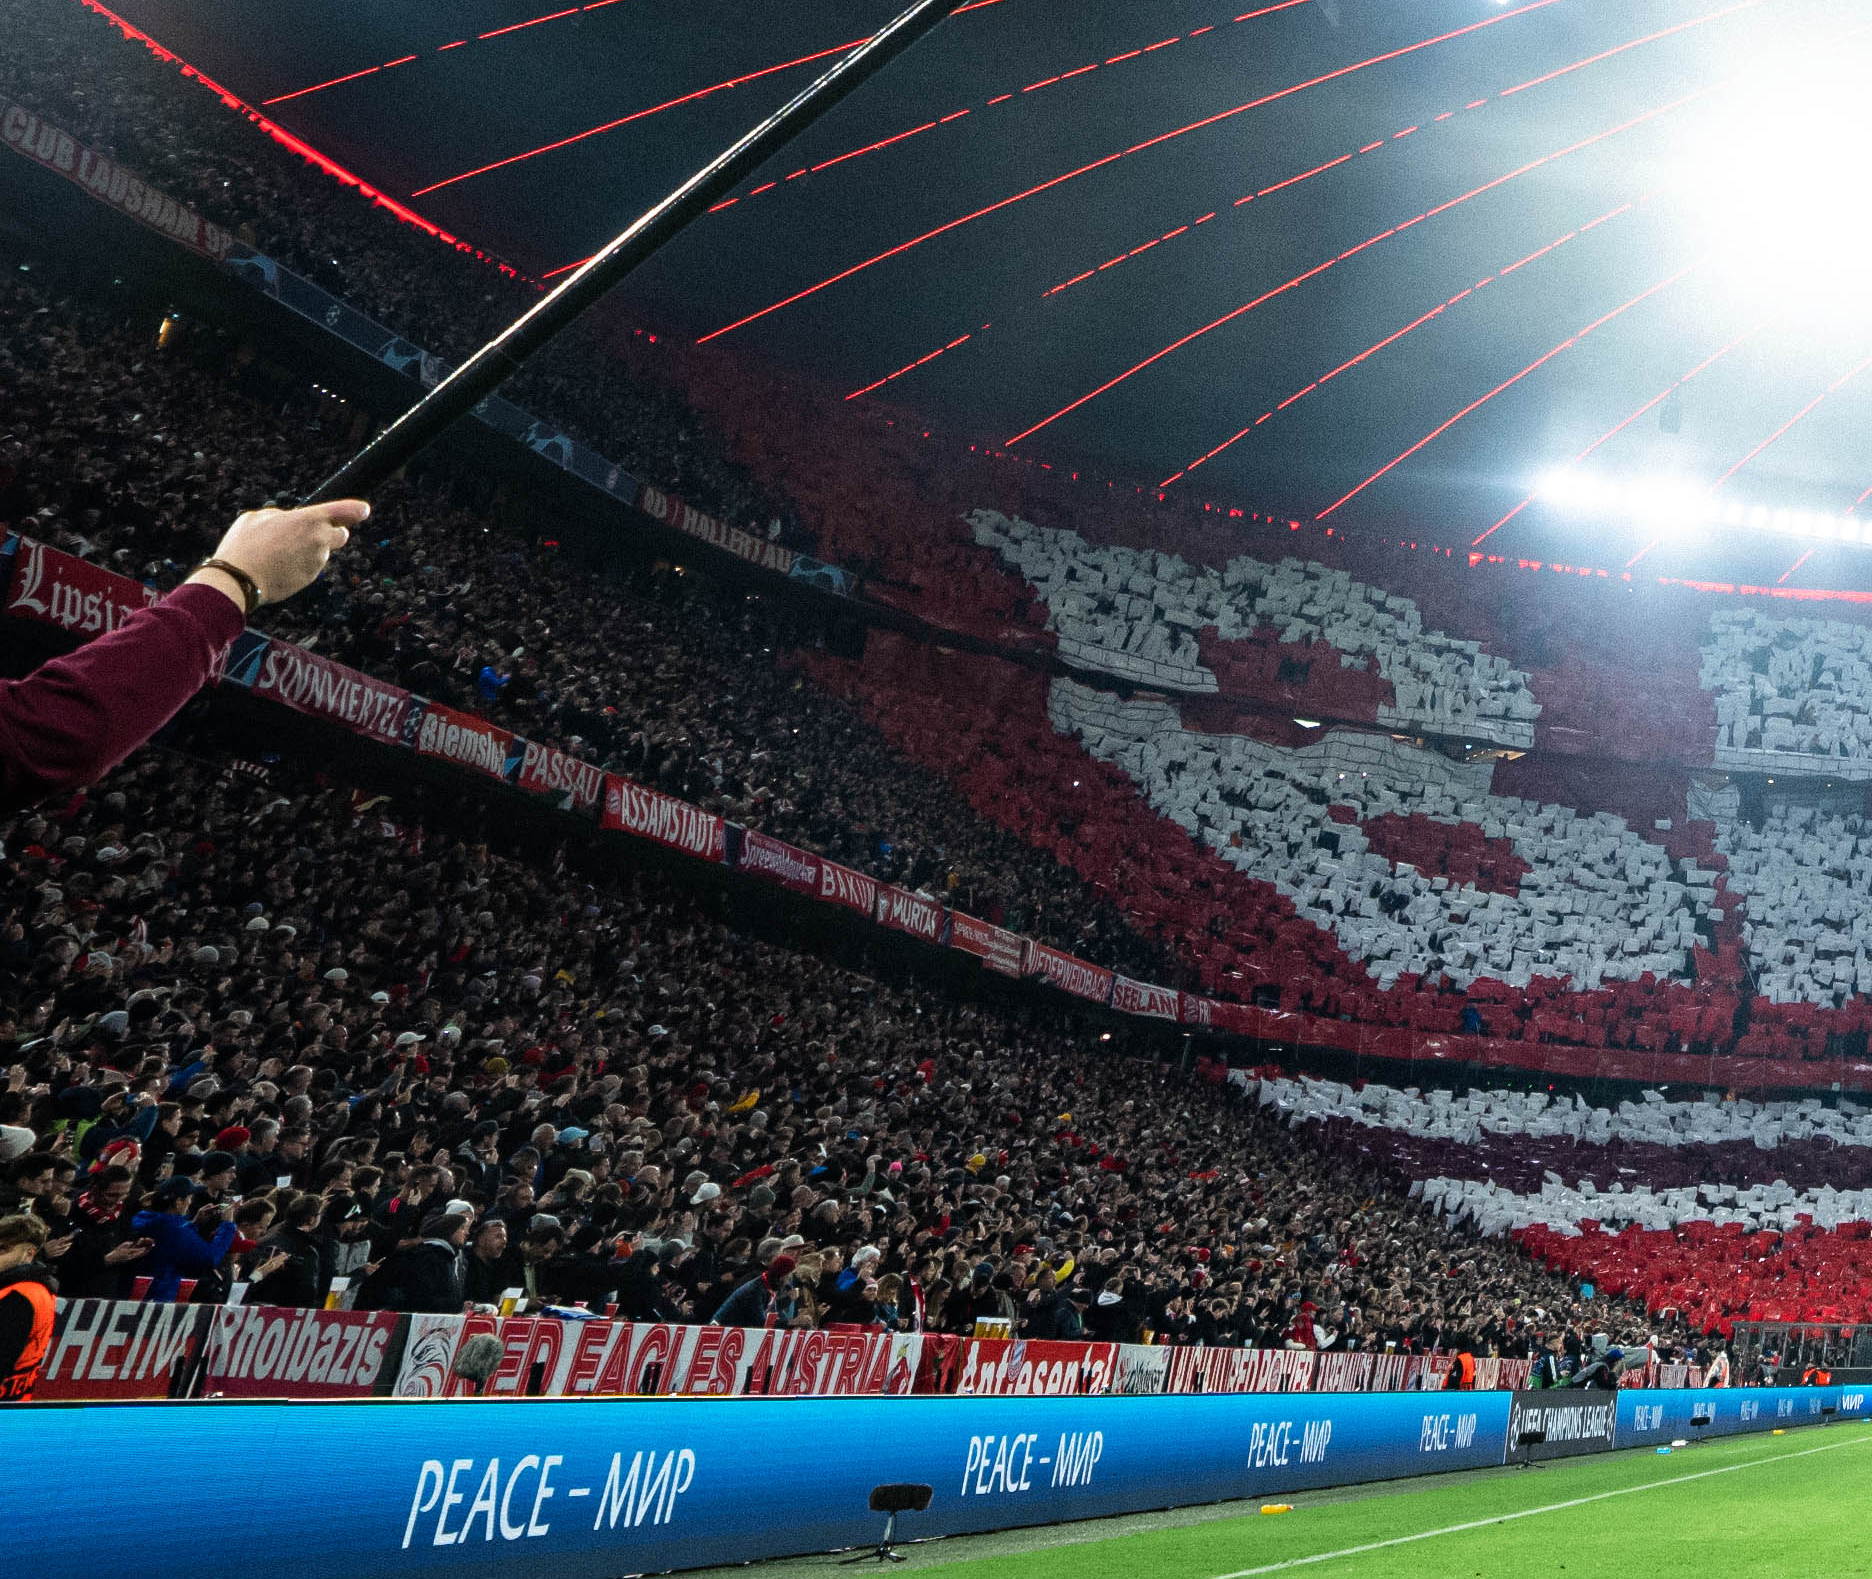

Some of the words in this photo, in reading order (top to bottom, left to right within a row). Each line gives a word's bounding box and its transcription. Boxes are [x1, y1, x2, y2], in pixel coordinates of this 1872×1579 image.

[520, 741, 603, 806] PASSAU
[621, 782, 716, 856] ASSAMSTADT
[206, 1305, 390, 1387] Rhoibazis
[563, 1323, 745, 1396] EAGLES
[743, 1330, 896, 1396] AUSTRIA
[1247, 1421, 1291, 1469] PEACE
[1419, 1413, 1449, 1453] PEACE
[1543, 1405, 1582, 1442] CHAMPIONS
[1583, 1404, 1609, 1438] LEAGUE
[401, 1454, 565, 1549] PEACE
[594, 1447, 697, 1531] МИР
[961, 1434, 1039, 1497] PEACE
